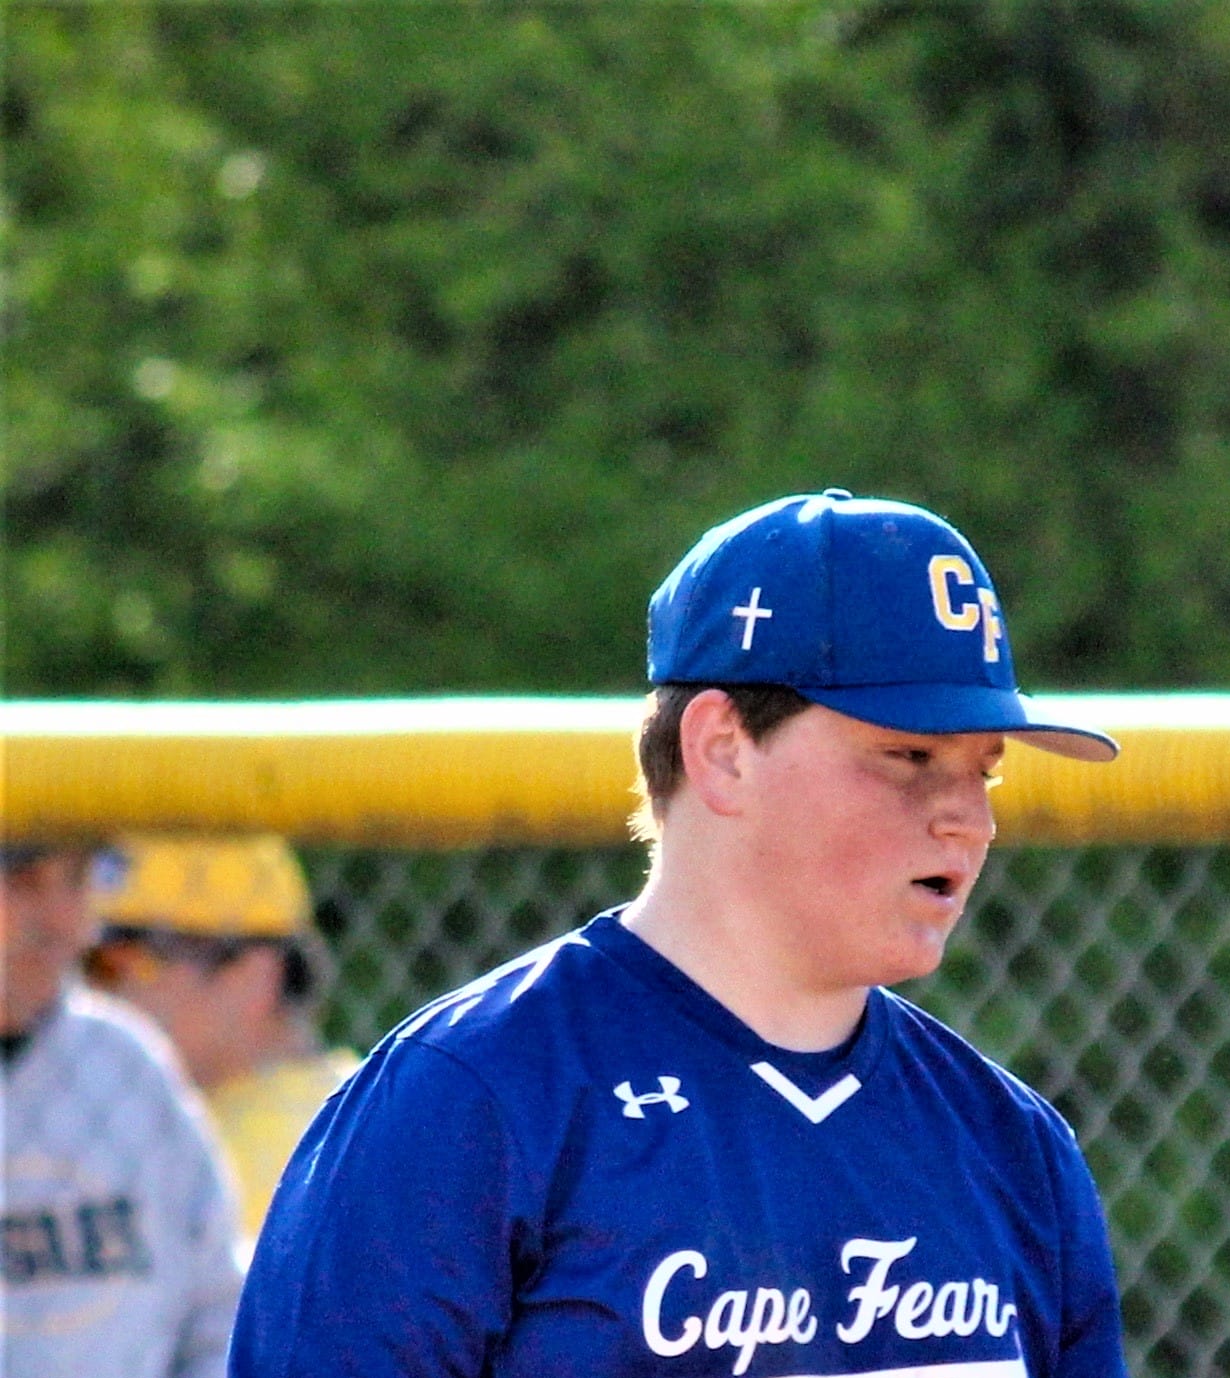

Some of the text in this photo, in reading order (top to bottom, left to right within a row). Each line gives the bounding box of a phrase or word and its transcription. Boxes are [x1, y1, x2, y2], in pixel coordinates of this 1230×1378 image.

[928, 554, 1002, 663] CF
[642, 1236, 1017, 1376] Cape Fear
